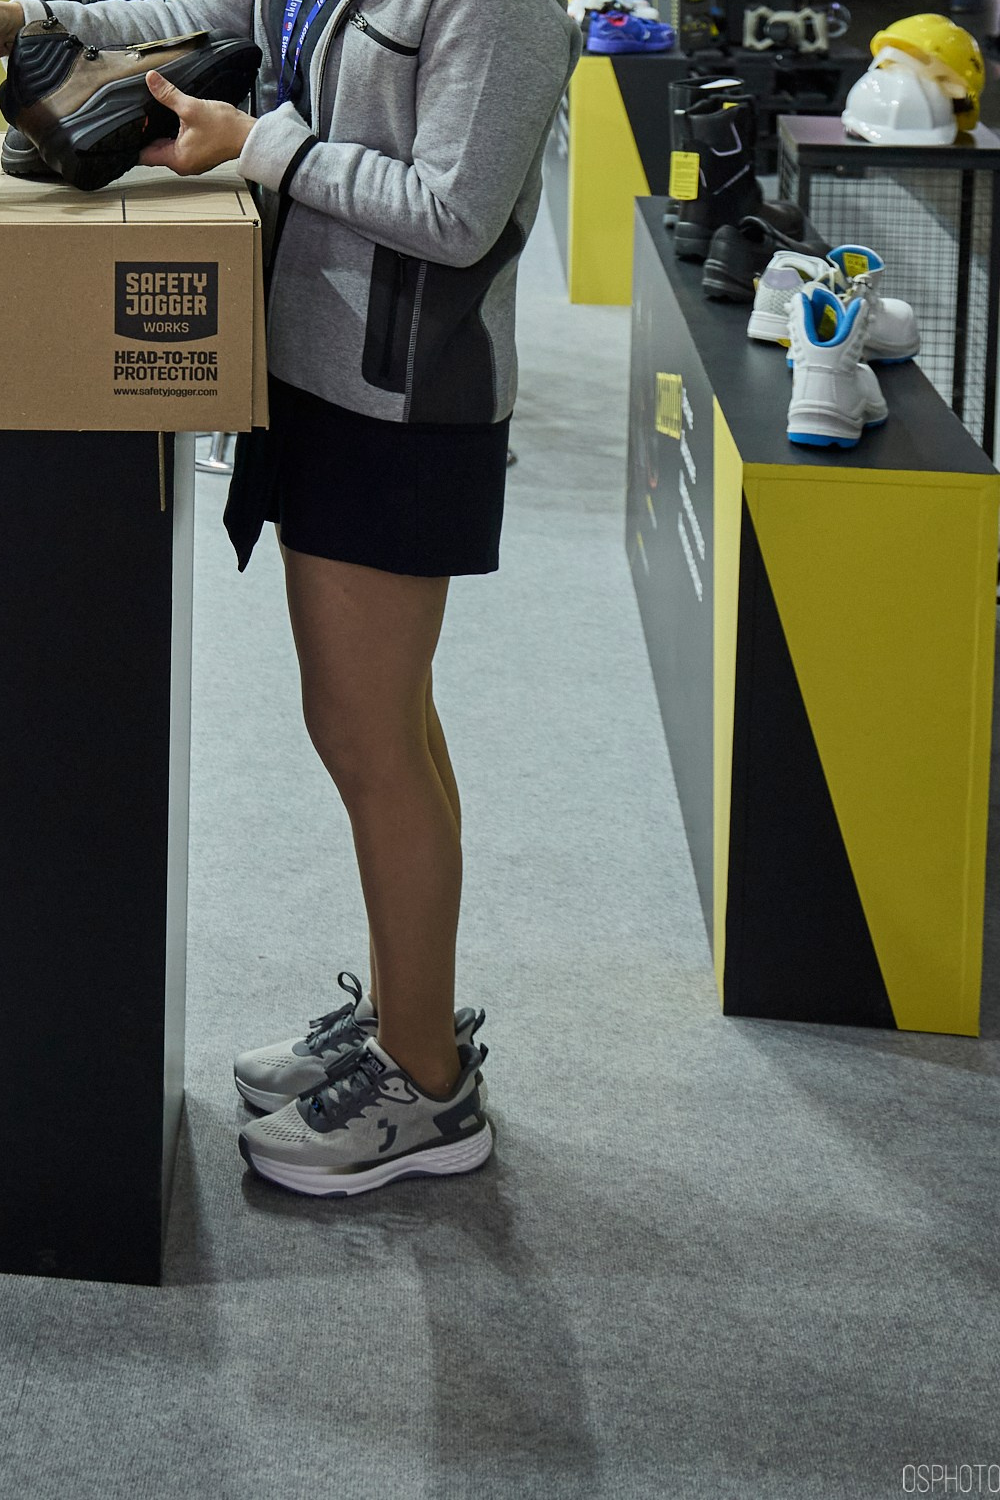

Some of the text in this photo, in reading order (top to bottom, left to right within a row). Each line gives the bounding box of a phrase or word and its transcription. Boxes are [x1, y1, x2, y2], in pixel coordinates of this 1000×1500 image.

[125, 272, 208, 294] SAFETY
[125, 294, 208, 316] JOGGER
[143, 322, 190, 333] WORKS
[114, 350, 218, 365] HEAD-TO-TOE
[114, 366, 218, 381] PROTECTION
[113, 386, 218, 397] www.safetyjogger.com
